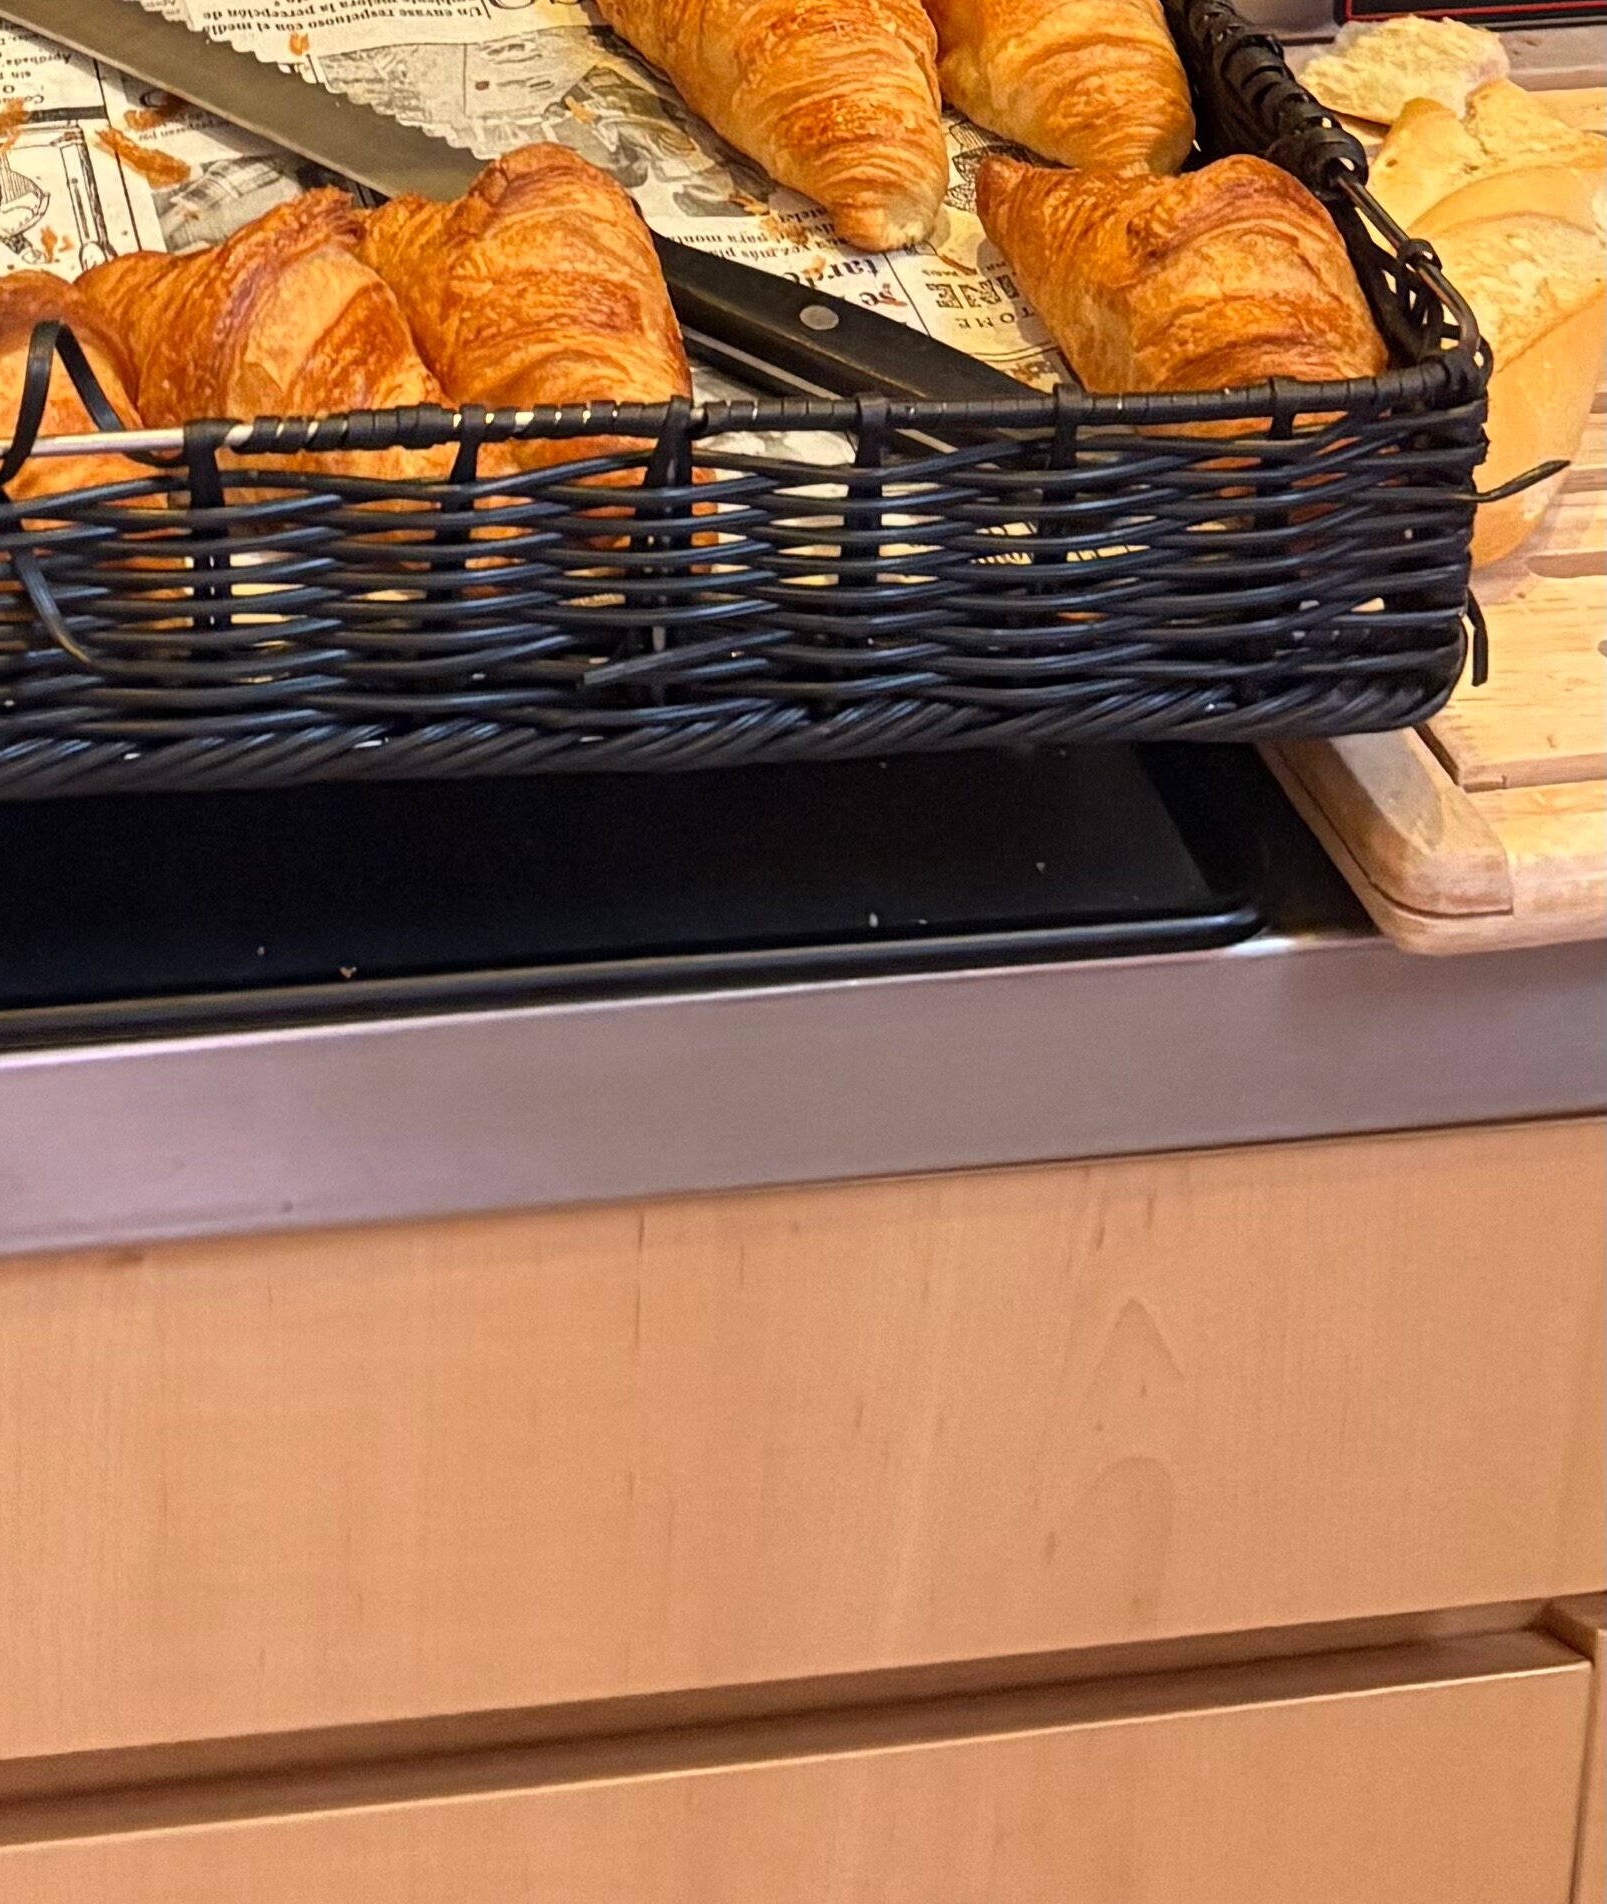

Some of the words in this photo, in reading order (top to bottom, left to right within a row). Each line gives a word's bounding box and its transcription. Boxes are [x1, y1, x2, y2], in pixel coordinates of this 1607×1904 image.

[227, 4, 316, 21] percepción
[319, 2, 334, 13] la
[399, 7, 453, 18] envase
[457, 6, 482, 18] Un
[202, 11, 223, 21] de
[308, 7, 394, 29] respetuoso
[256, 22, 270, 33] el
[275, 22, 303, 32] con
